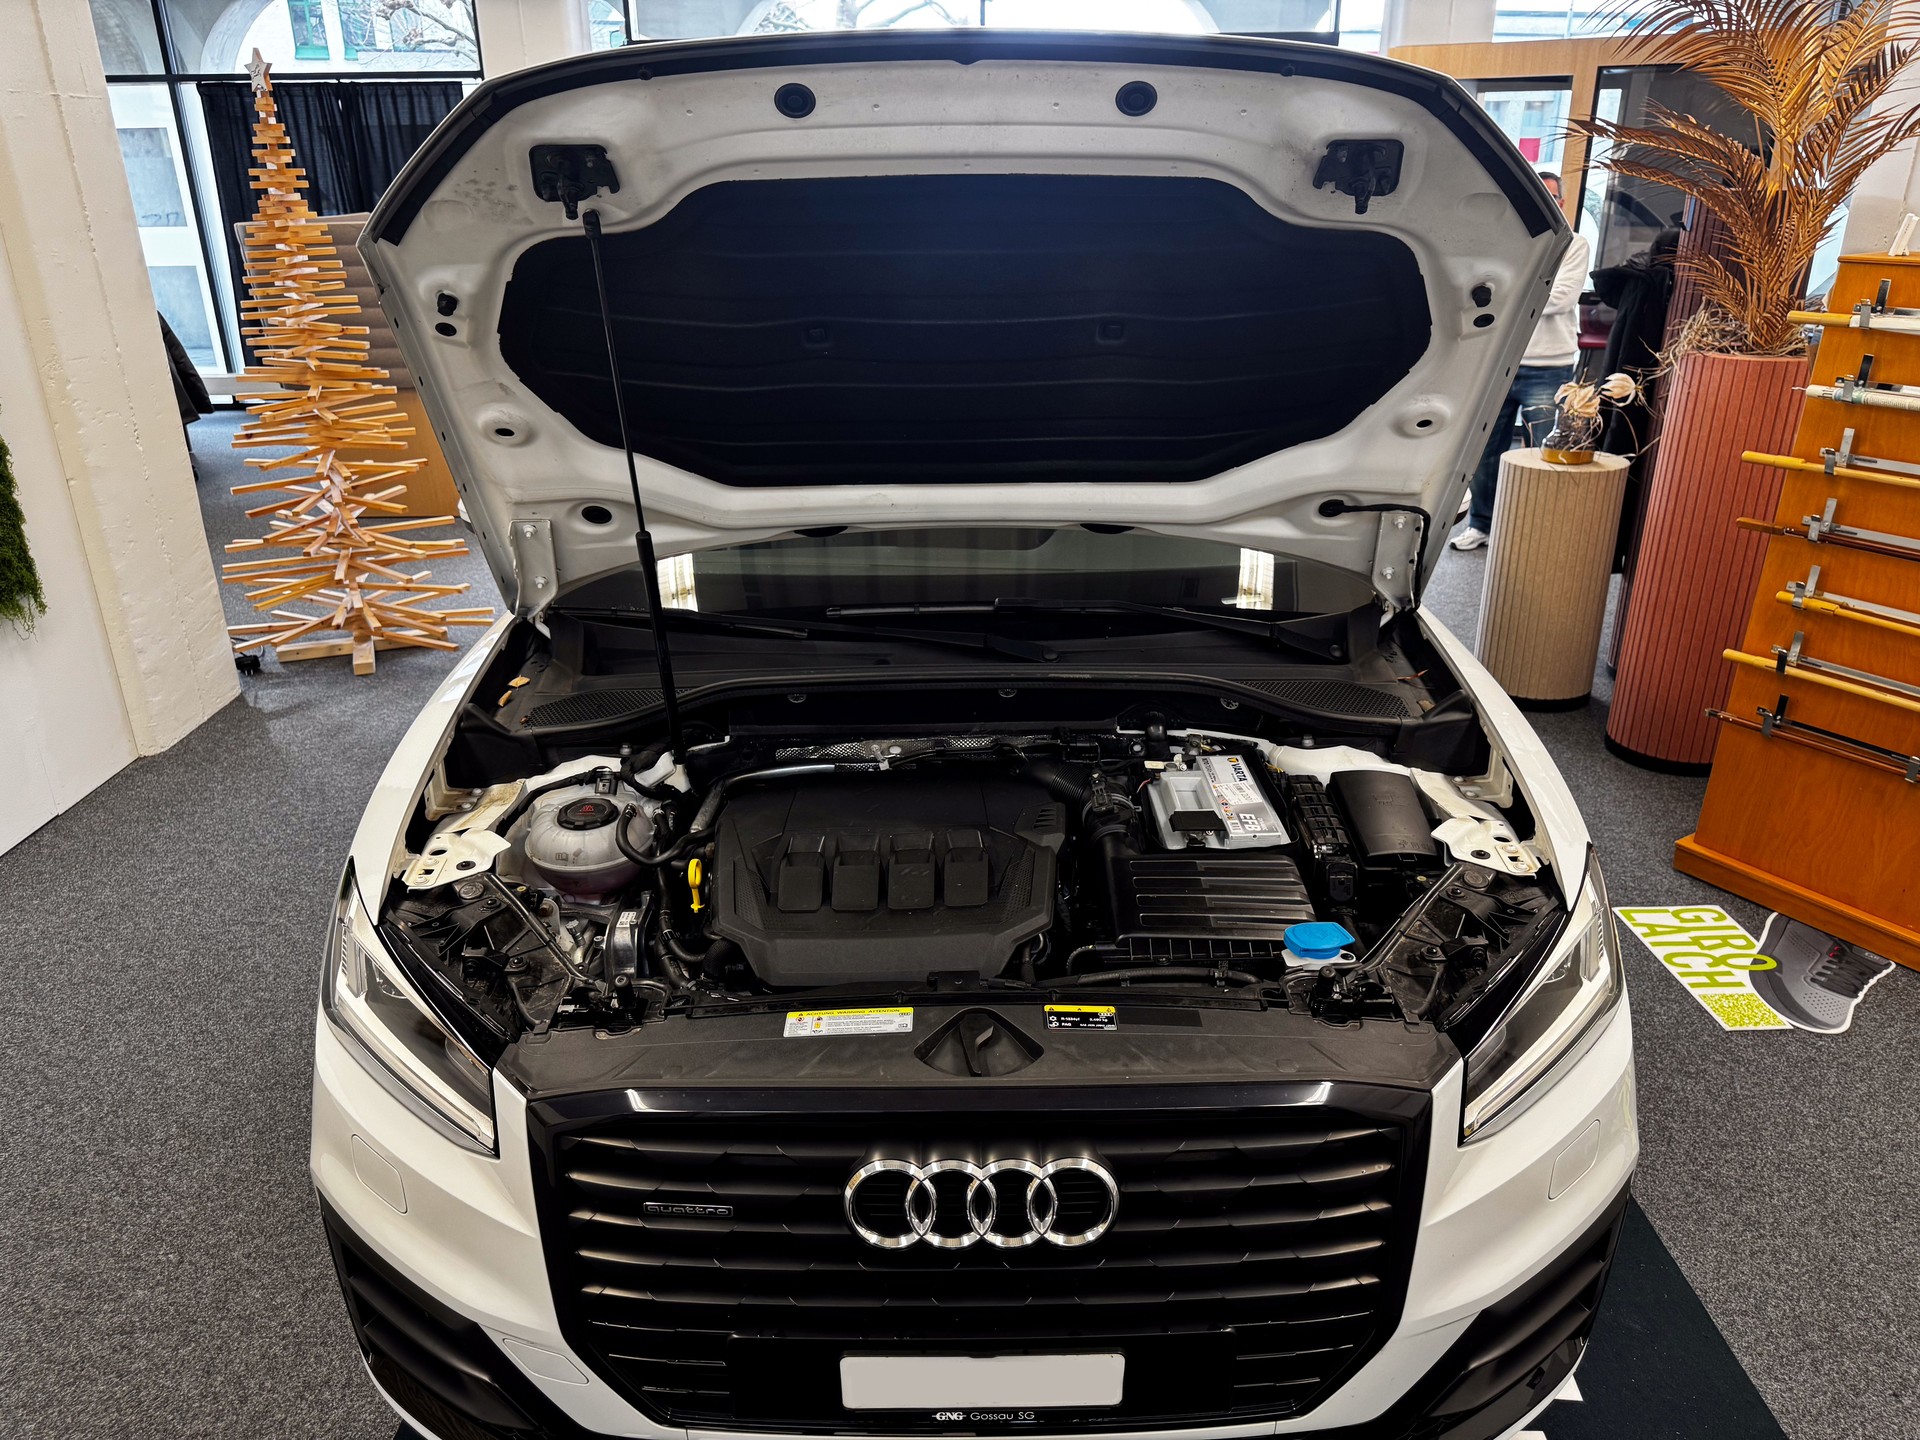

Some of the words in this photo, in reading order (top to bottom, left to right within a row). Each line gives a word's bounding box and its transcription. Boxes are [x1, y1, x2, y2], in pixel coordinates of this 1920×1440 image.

[1231, 763, 1248, 782] VARTA
[1239, 813, 1261, 832] EFB
[1618, 908, 1747, 989] LATCH
[1671, 907, 1778, 971] GIRO
[647, 1205, 729, 1215] quattro
[935, 1411, 964, 1421] GNG
[970, 1411, 1013, 1420] Gossau
[1018, 1411, 1034, 1420] SG
